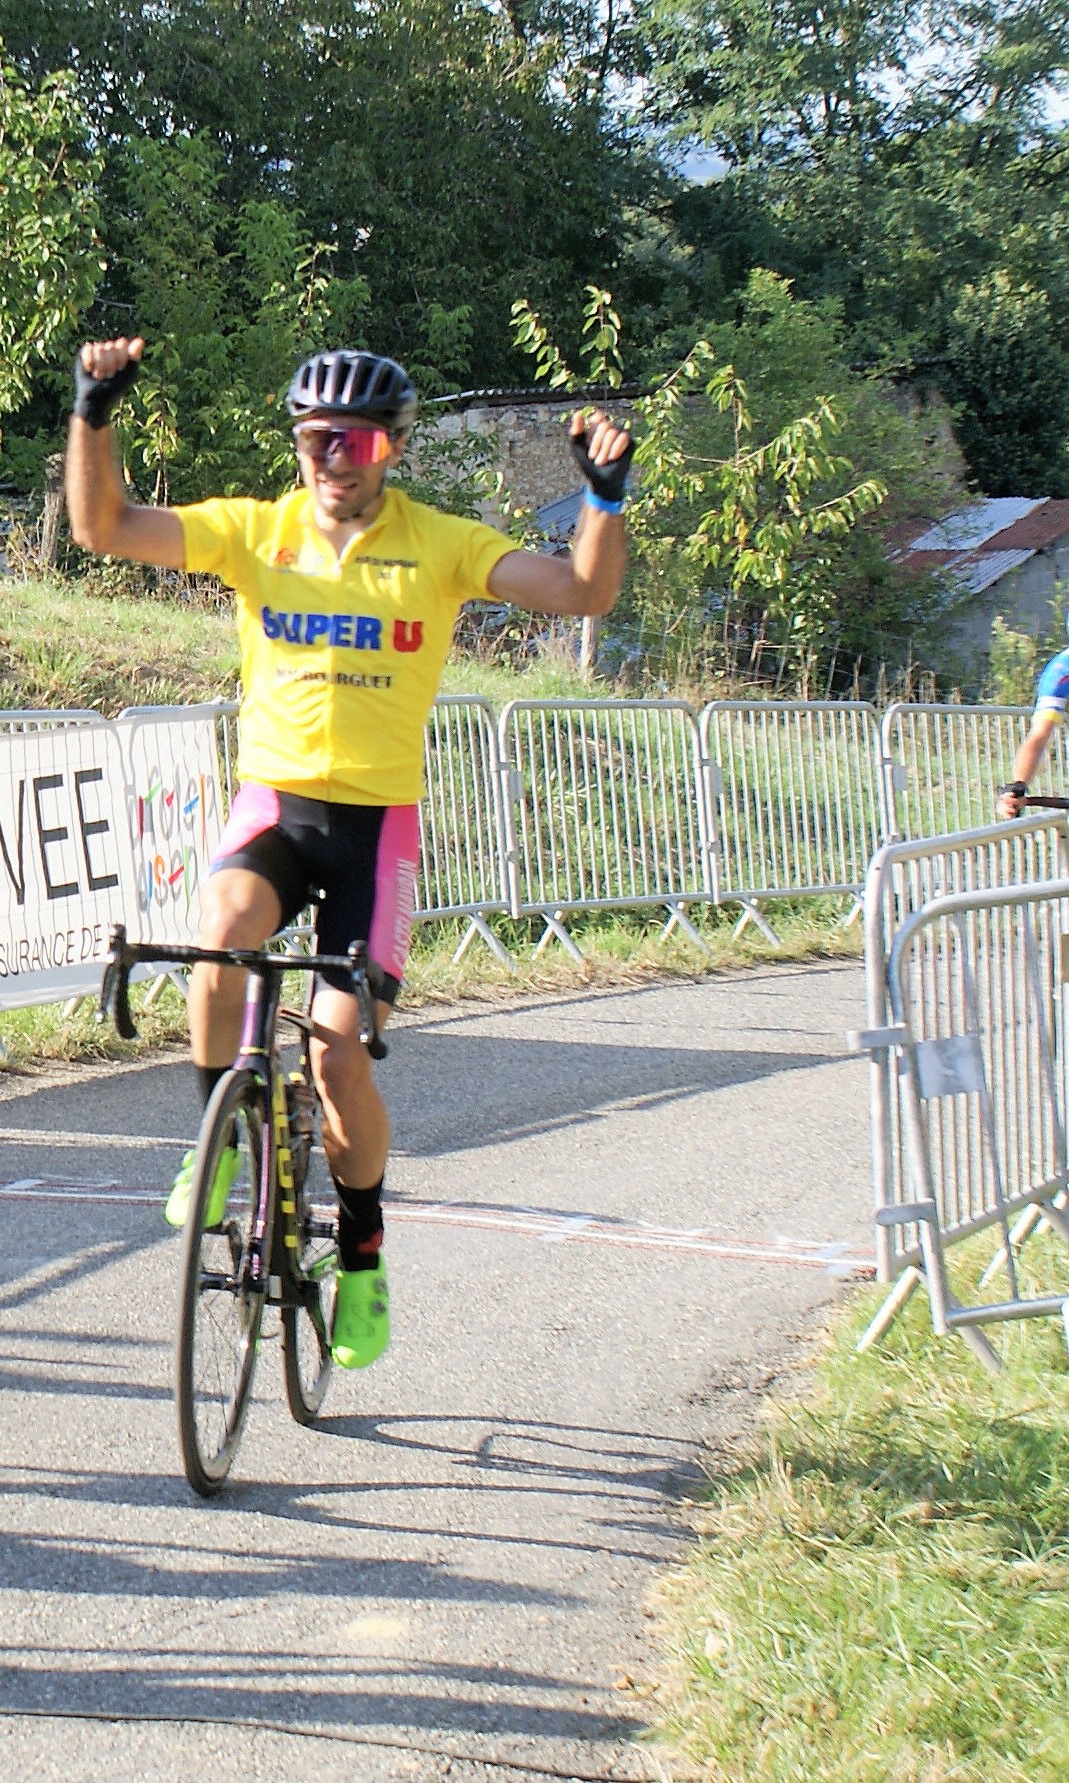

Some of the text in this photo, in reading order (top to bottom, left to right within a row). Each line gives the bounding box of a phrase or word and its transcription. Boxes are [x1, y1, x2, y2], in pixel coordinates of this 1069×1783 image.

[261, 605, 424, 653] SUPER U
[80, 923, 103, 961] DE
